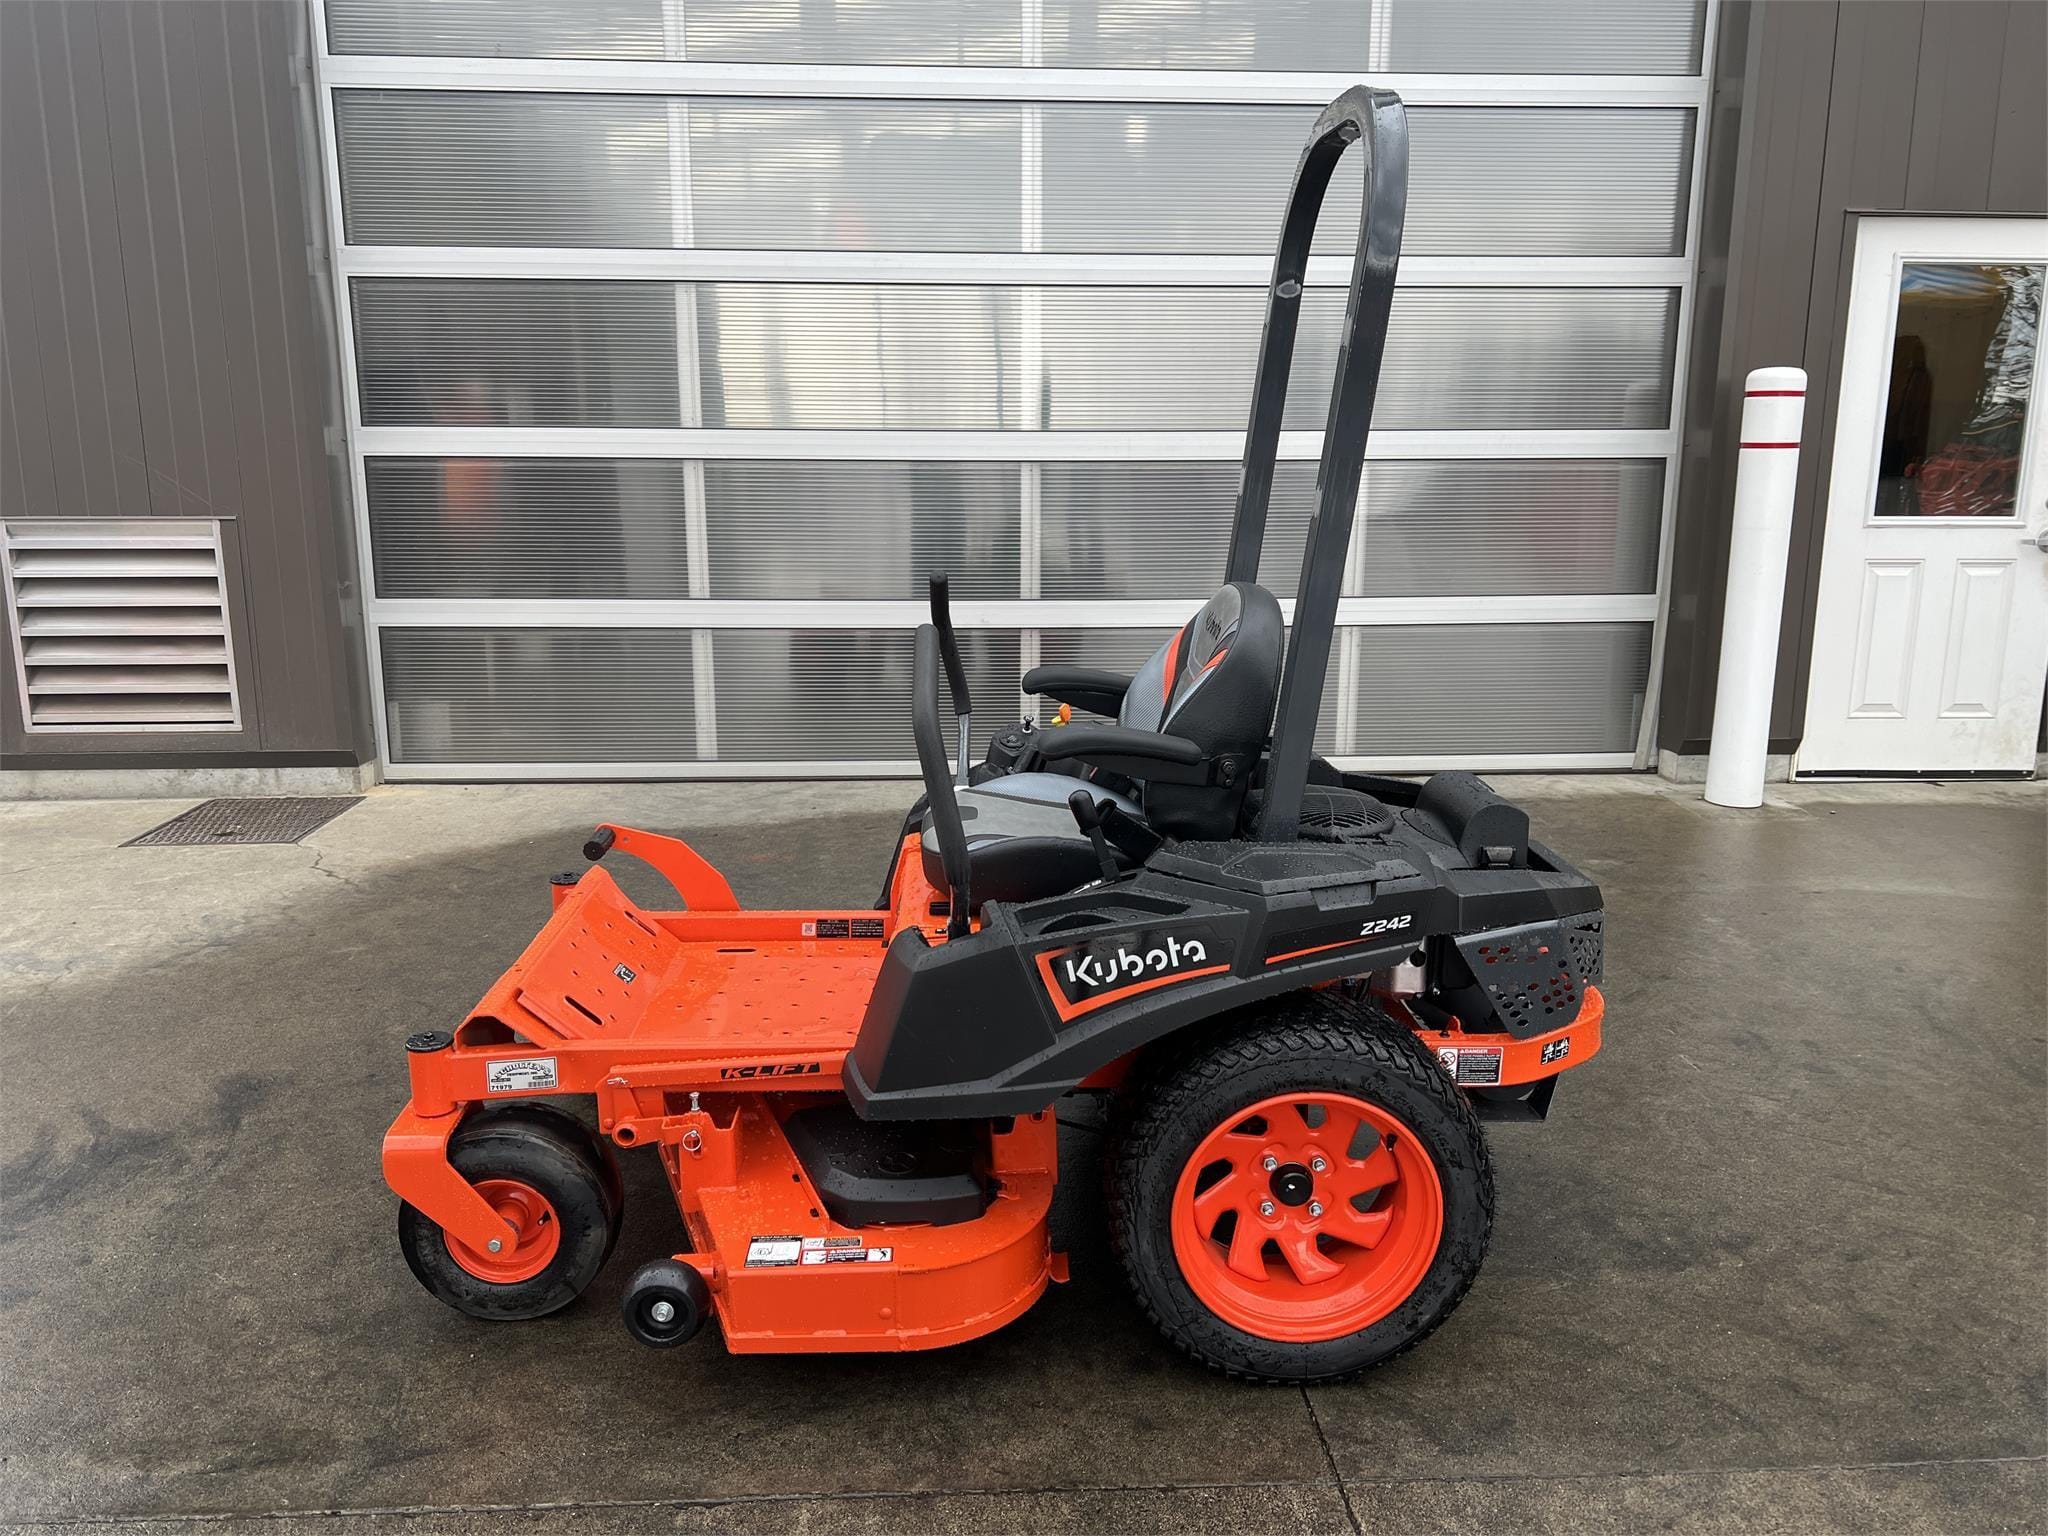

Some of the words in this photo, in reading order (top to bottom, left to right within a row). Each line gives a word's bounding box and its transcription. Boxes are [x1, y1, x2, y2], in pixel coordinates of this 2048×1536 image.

[1360, 914, 1412, 936] Z242
[1065, 936, 1208, 986] Kubota
[724, 1062, 818, 1078] K-LIFT
